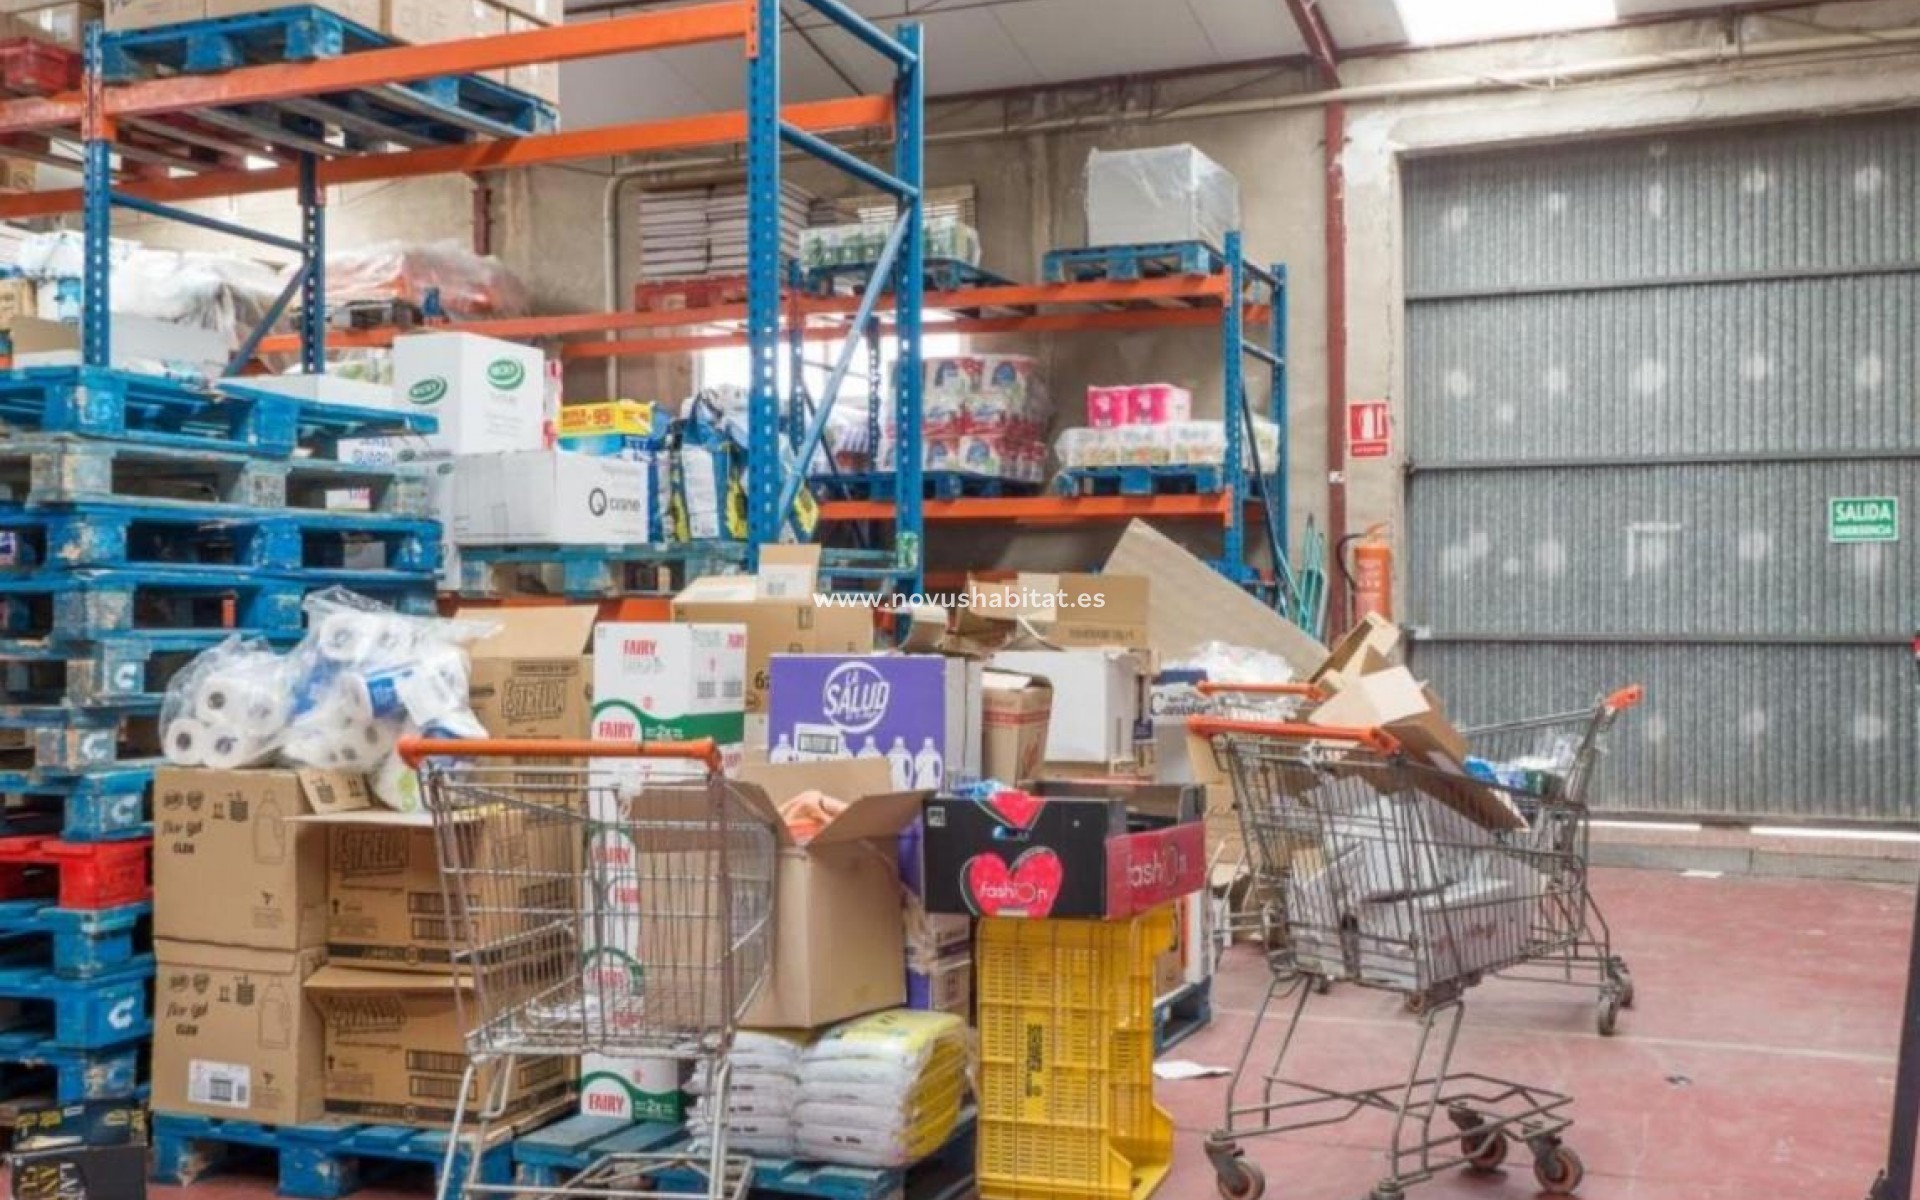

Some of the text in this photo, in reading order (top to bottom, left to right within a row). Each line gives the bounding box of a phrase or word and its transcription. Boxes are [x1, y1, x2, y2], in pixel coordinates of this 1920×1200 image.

[1835, 502, 1892, 522] SALIDA
[624, 639, 657, 655] FAIRY
[826, 681, 891, 716] SALUD
[598, 720, 636, 739] FAIRY
[588, 1093, 624, 1113] FAIRY
